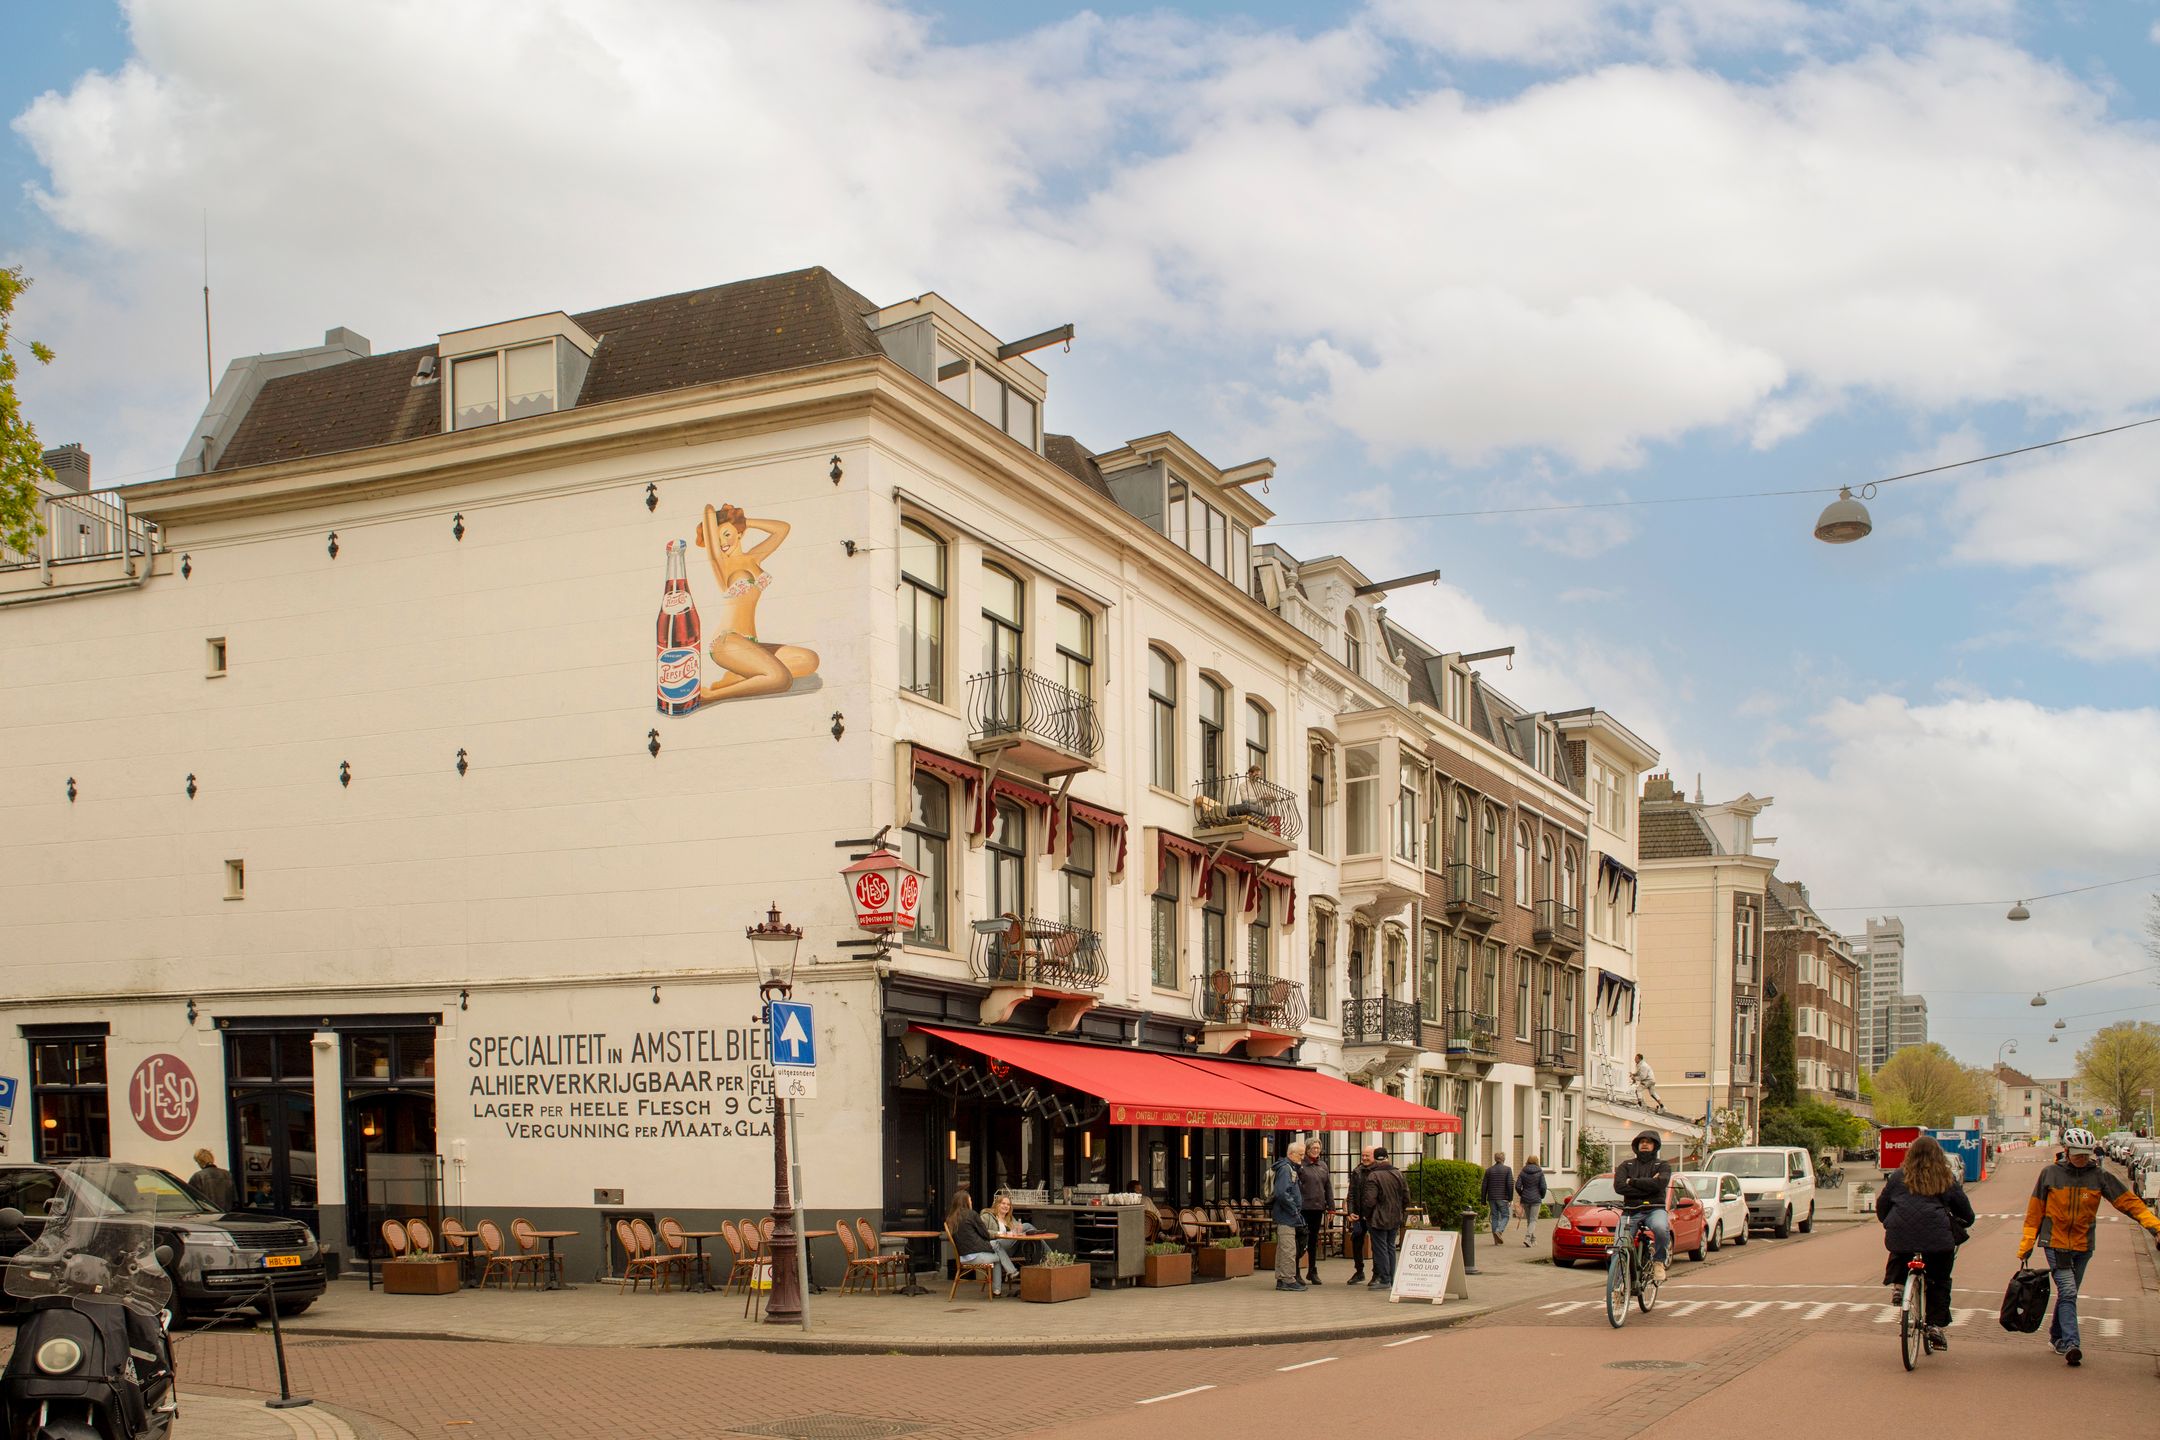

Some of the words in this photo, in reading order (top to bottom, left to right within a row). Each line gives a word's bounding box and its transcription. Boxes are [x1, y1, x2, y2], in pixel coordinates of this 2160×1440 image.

[858, 873, 888, 907] HESP
[901, 876, 918, 909] HESP
[469, 1033, 606, 1068] SPECIALITEIT
[608, 1048, 622, 1064] IN
[778, 1068, 815, 1078] uitgezonderd
[717, 1076, 743, 1092] PER
[135, 1058, 196, 1135] HESP
[474, 1103, 534, 1118] LAGER
[540, 1105, 563, 1117] PER
[570, 1101, 629, 1117] HEELE
[639, 1100, 711, 1116] FLESCH
[725, 1097, 739, 1114] 9
[1162, 1113, 1180, 1121] LUNCH
[1186, 1111, 1206, 1124] CAFE
[1213, 1112, 1256, 1126] RESTAURANT
[1262, 1113, 1279, 1126] HESP
[1382, 1119, 1410, 1130] RESTAURANT
[506, 1122, 629, 1138] VERGUNNING
[635, 1126, 657, 1138] PER
[661, 1120, 722, 1138] MAAT
[735, 1120, 776, 1138] GLA
[1885, 1141, 1912, 1149] bo-rent.n
